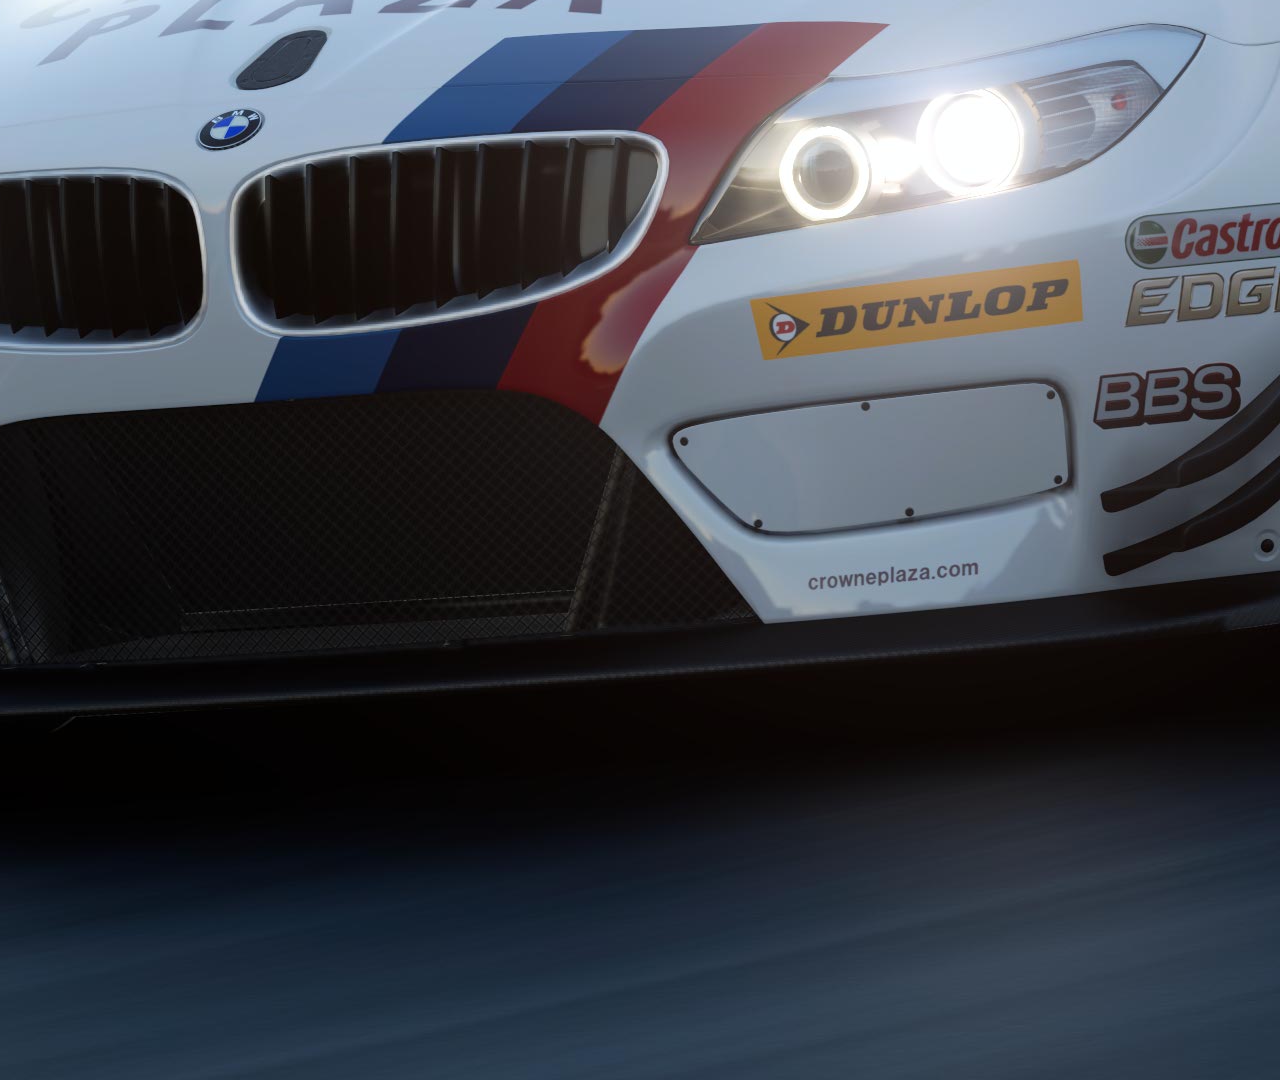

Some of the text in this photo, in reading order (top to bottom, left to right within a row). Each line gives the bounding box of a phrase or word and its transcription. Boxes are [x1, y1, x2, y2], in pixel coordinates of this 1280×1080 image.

[815, 277, 1069, 339] DUNLOP
[1093, 363, 1241, 430] BBS
[807, 559, 980, 592] crowneplaza.com
